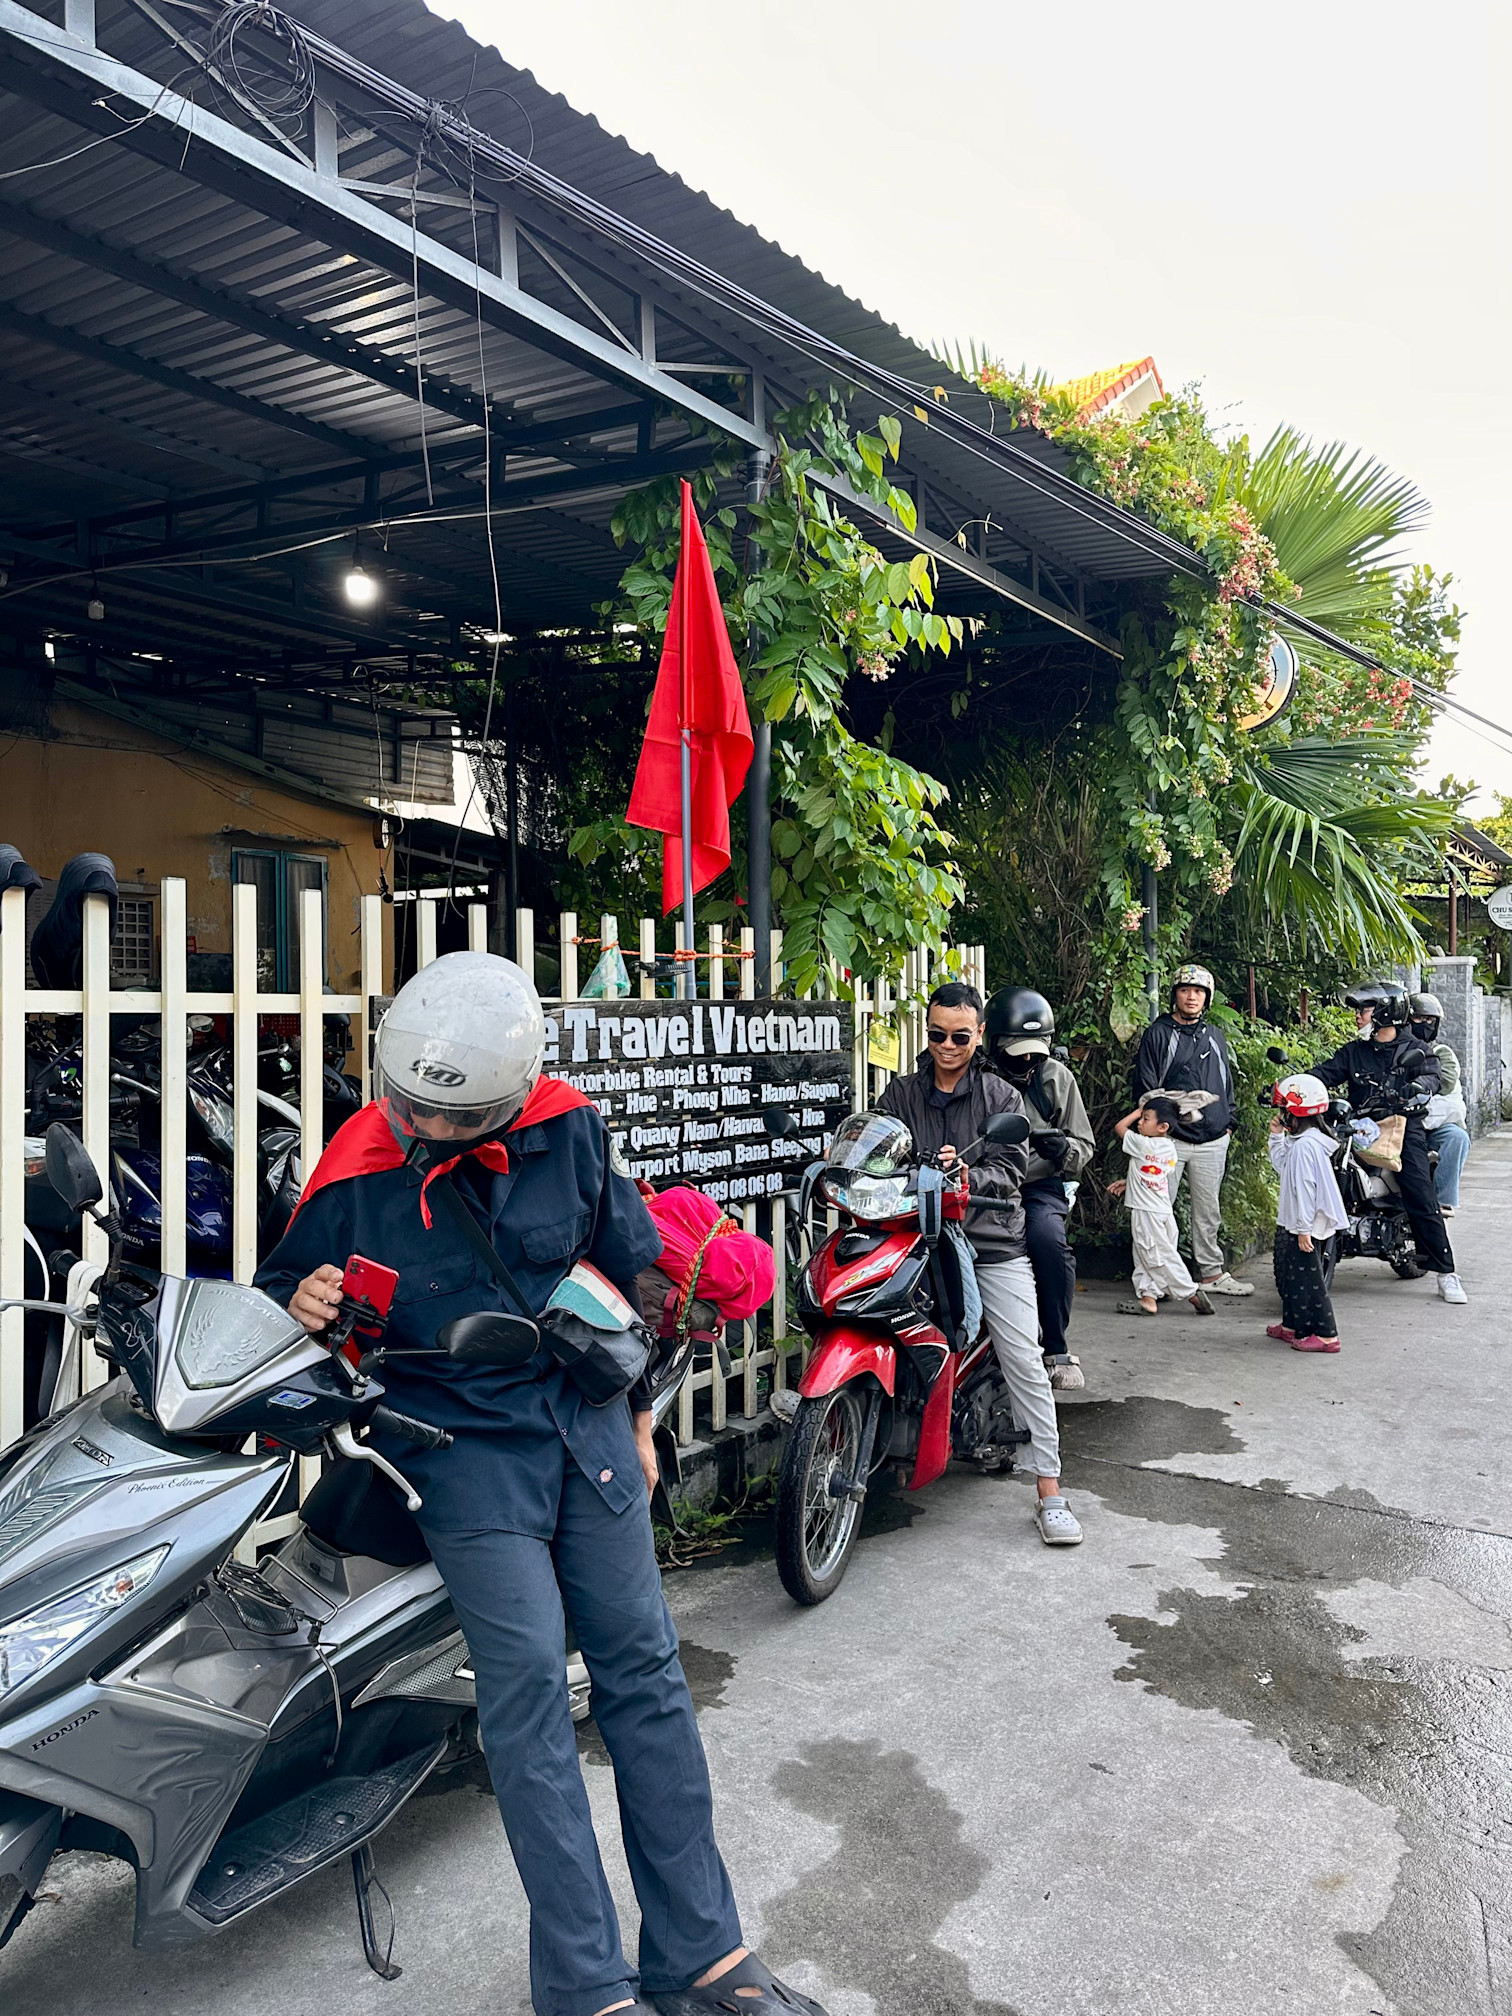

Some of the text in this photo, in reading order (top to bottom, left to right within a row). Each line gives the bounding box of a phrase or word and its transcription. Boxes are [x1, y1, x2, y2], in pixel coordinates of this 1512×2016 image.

[564, 1005, 704, 1062] Travel
[709, 1006, 841, 1054] Vietnam
[643, 1065, 694, 1088] Rental
[697, 1064, 708, 1084] &
[711, 1064, 752, 1083] Tours
[626, 1092, 657, 1114] Hue
[673, 1089, 719, 1111] Phong
[721, 1086, 750, 1106] Nha
[630, 1126, 680, 1152] Quang
[802, 1108, 825, 1127] Hue
[682, 1149, 732, 1173] Myson
[735, 1143, 770, 1164] Bana
[729, 1177, 747, 1199] 08
[748, 1175, 765, 1195] 06
[766, 1172, 783, 1192] 08
[121, 1232, 145, 1246] ONDA
[891, 1311, 916, 1324] HONDA
[128, 1477, 205, 1494] Phoenix Edition
[31, 1709, 101, 1751] HONDA
